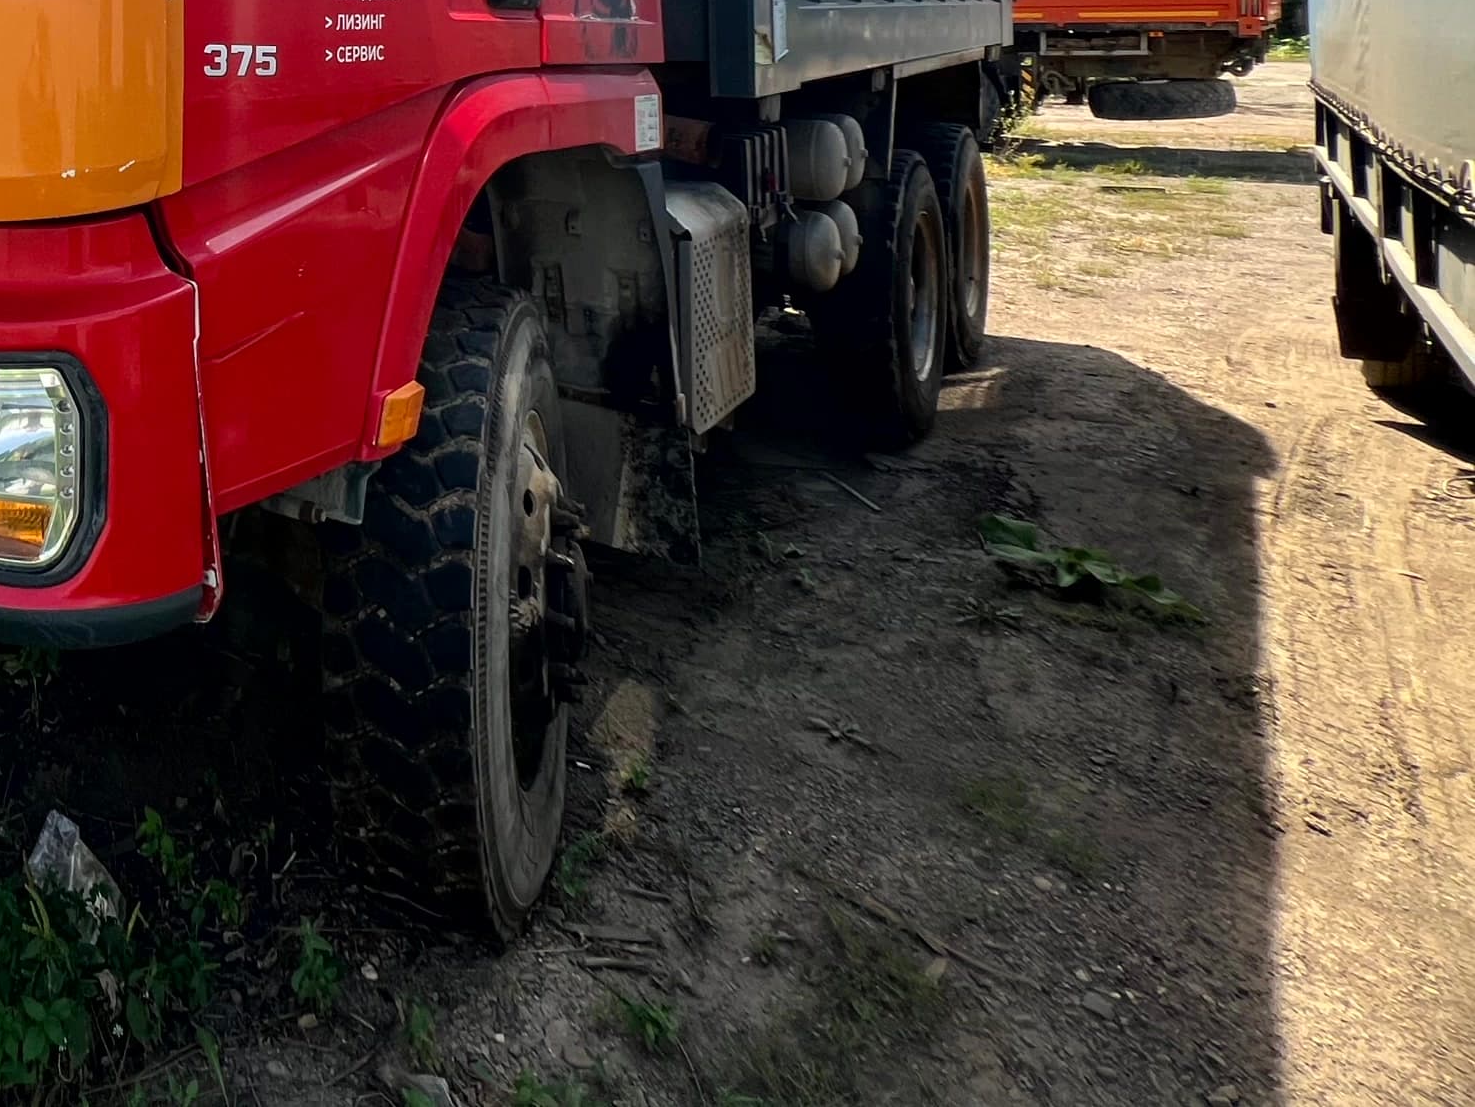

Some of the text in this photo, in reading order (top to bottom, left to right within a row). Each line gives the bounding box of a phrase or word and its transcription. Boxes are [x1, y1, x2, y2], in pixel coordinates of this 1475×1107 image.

[336, 14, 385, 30] ЛИЗИНГ
[203, 43, 277, 77] 375
[336, 45, 385, 62] СЕРВИС
